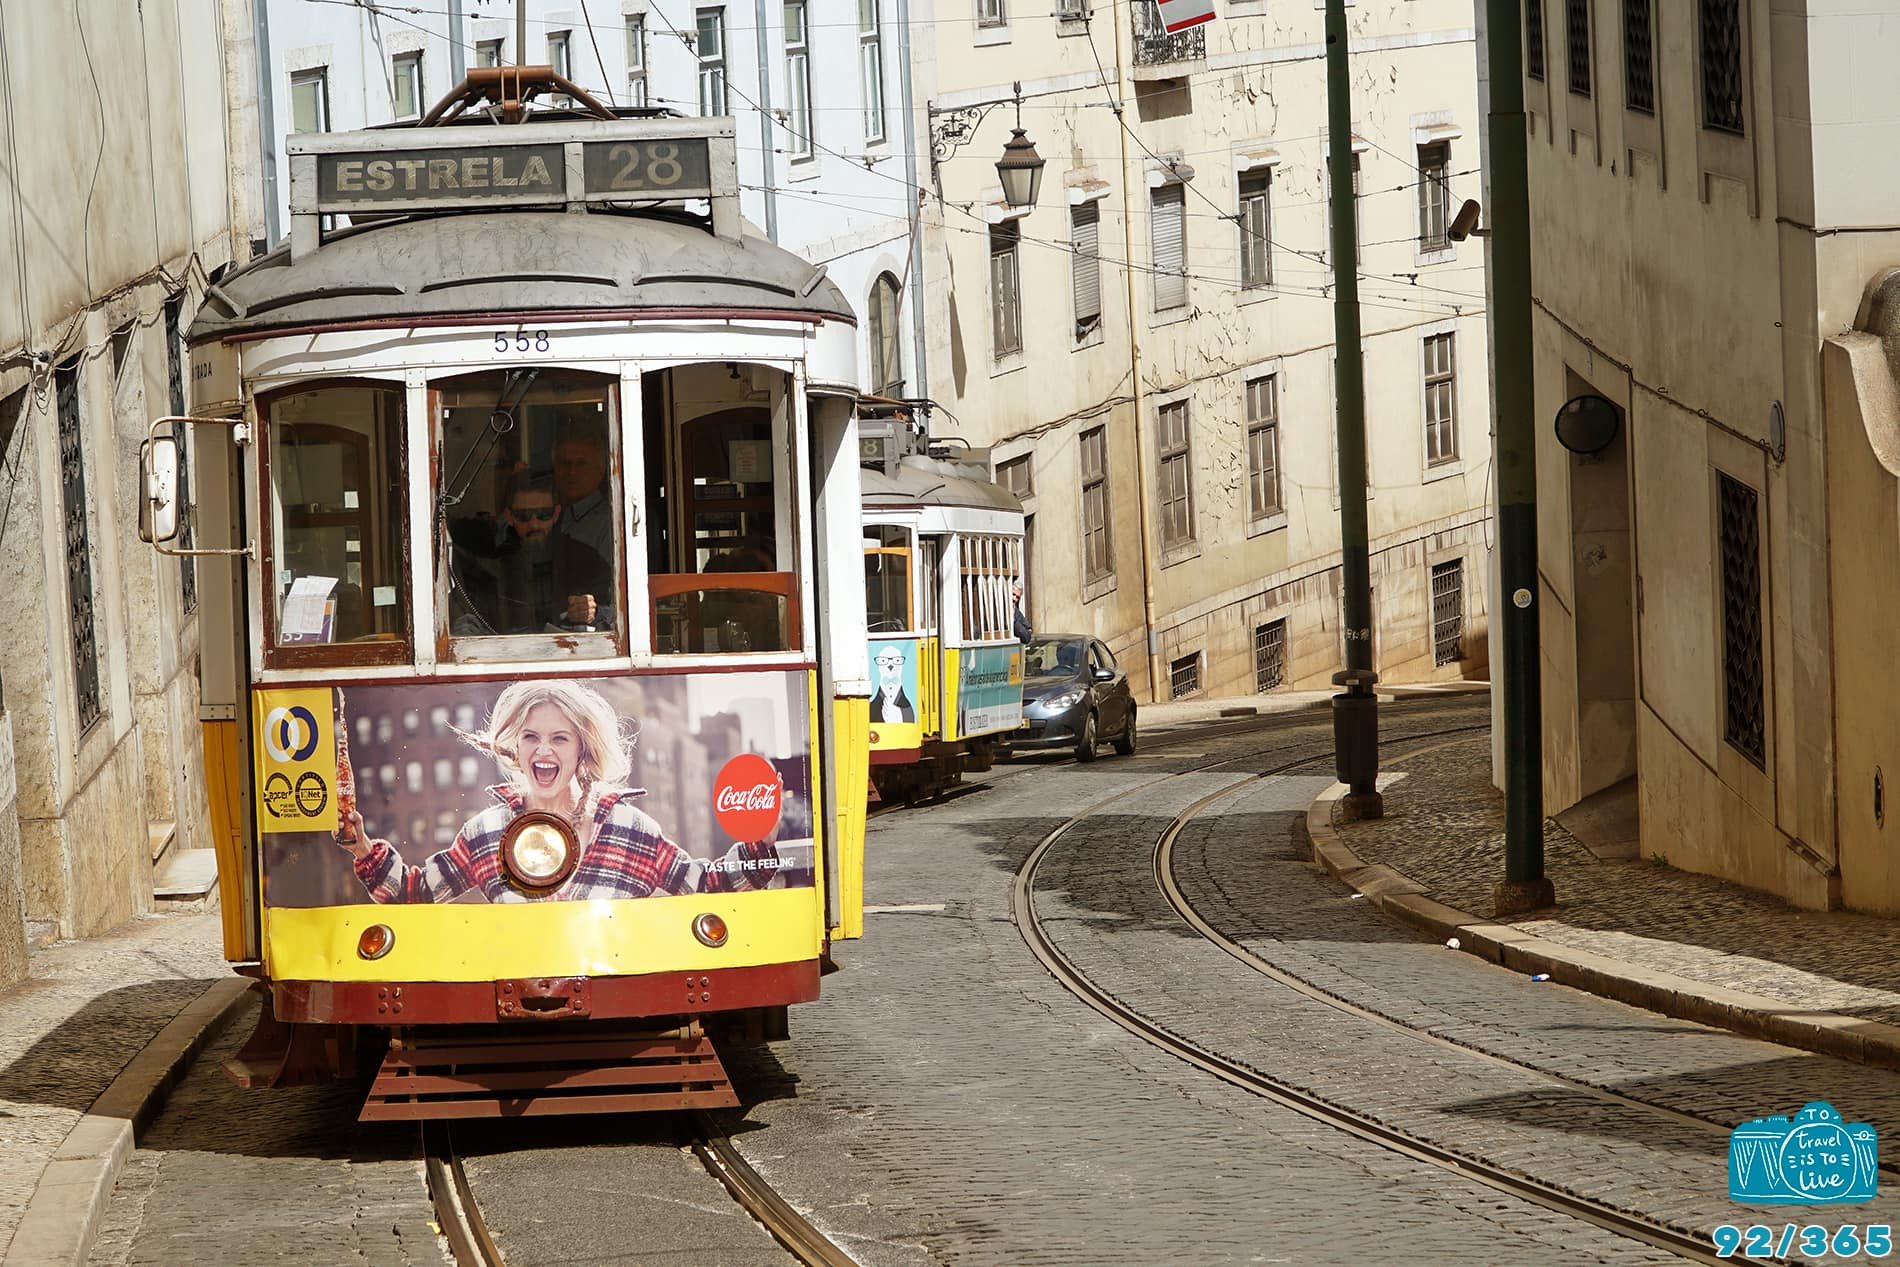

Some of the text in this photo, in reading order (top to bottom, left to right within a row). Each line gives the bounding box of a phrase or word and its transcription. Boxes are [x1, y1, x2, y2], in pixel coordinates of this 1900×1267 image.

[336, 142, 684, 192] ESTRELA 28
[495, 329, 549, 353] 558
[717, 783, 778, 812] Coca-Cola
[703, 857, 795, 873] TASTE THE FEELING
